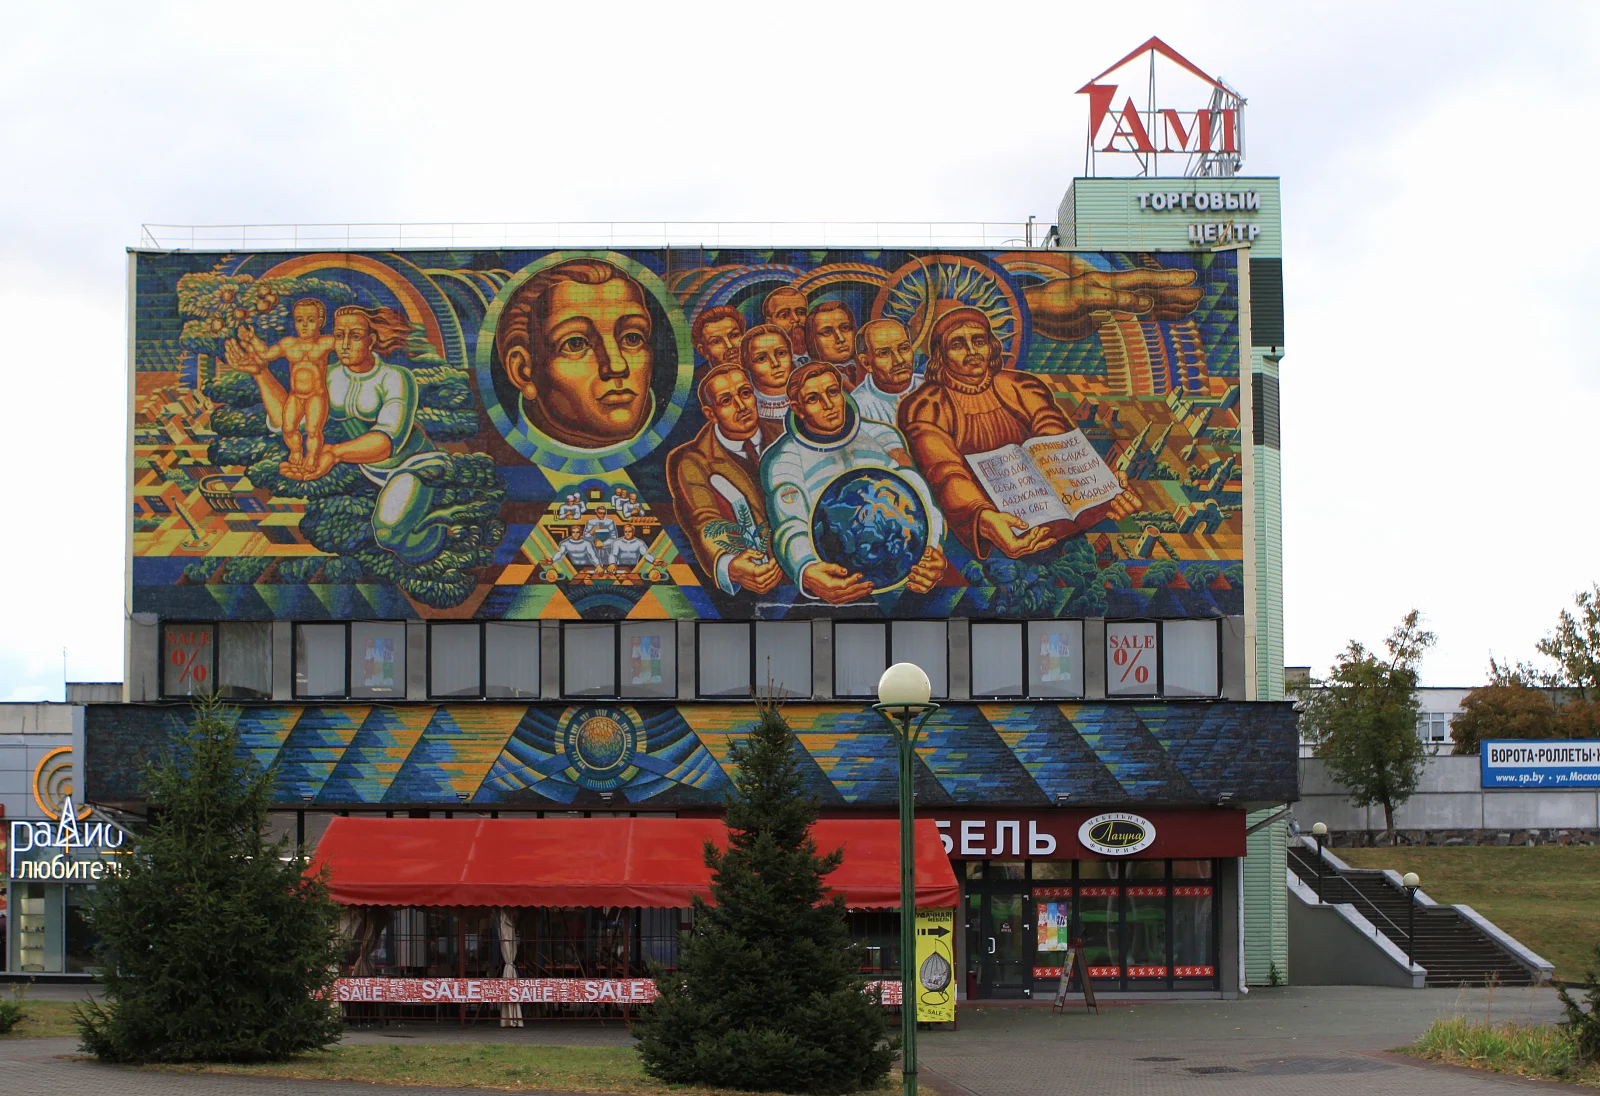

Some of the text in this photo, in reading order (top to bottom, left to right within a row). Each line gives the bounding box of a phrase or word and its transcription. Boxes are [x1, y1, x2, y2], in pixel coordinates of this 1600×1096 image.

[1137, 188, 1261, 212] ТОРГОВЫЙ
[1188, 223, 1262, 244] ЦЕНТР
[167, 631, 212, 646] SALE
[1109, 635, 1155, 649] SALE
[1491, 749, 1534, 762] ВОРОТА
[1538, 748, 1592, 762] РОЛЛЕТЫ
[1088, 814, 1146, 826] МЕБЕЛЬНАЯ
[1093, 821, 1142, 846] Лагуна
[1089, 842, 1146, 854] ФАБРИКА
[422, 981, 481, 999] SALE
[520, 979, 540, 987] SALE
[584, 981, 645, 1000] SALE
[340, 986, 383, 1001] SALE
[509, 986, 554, 1002] SALE
